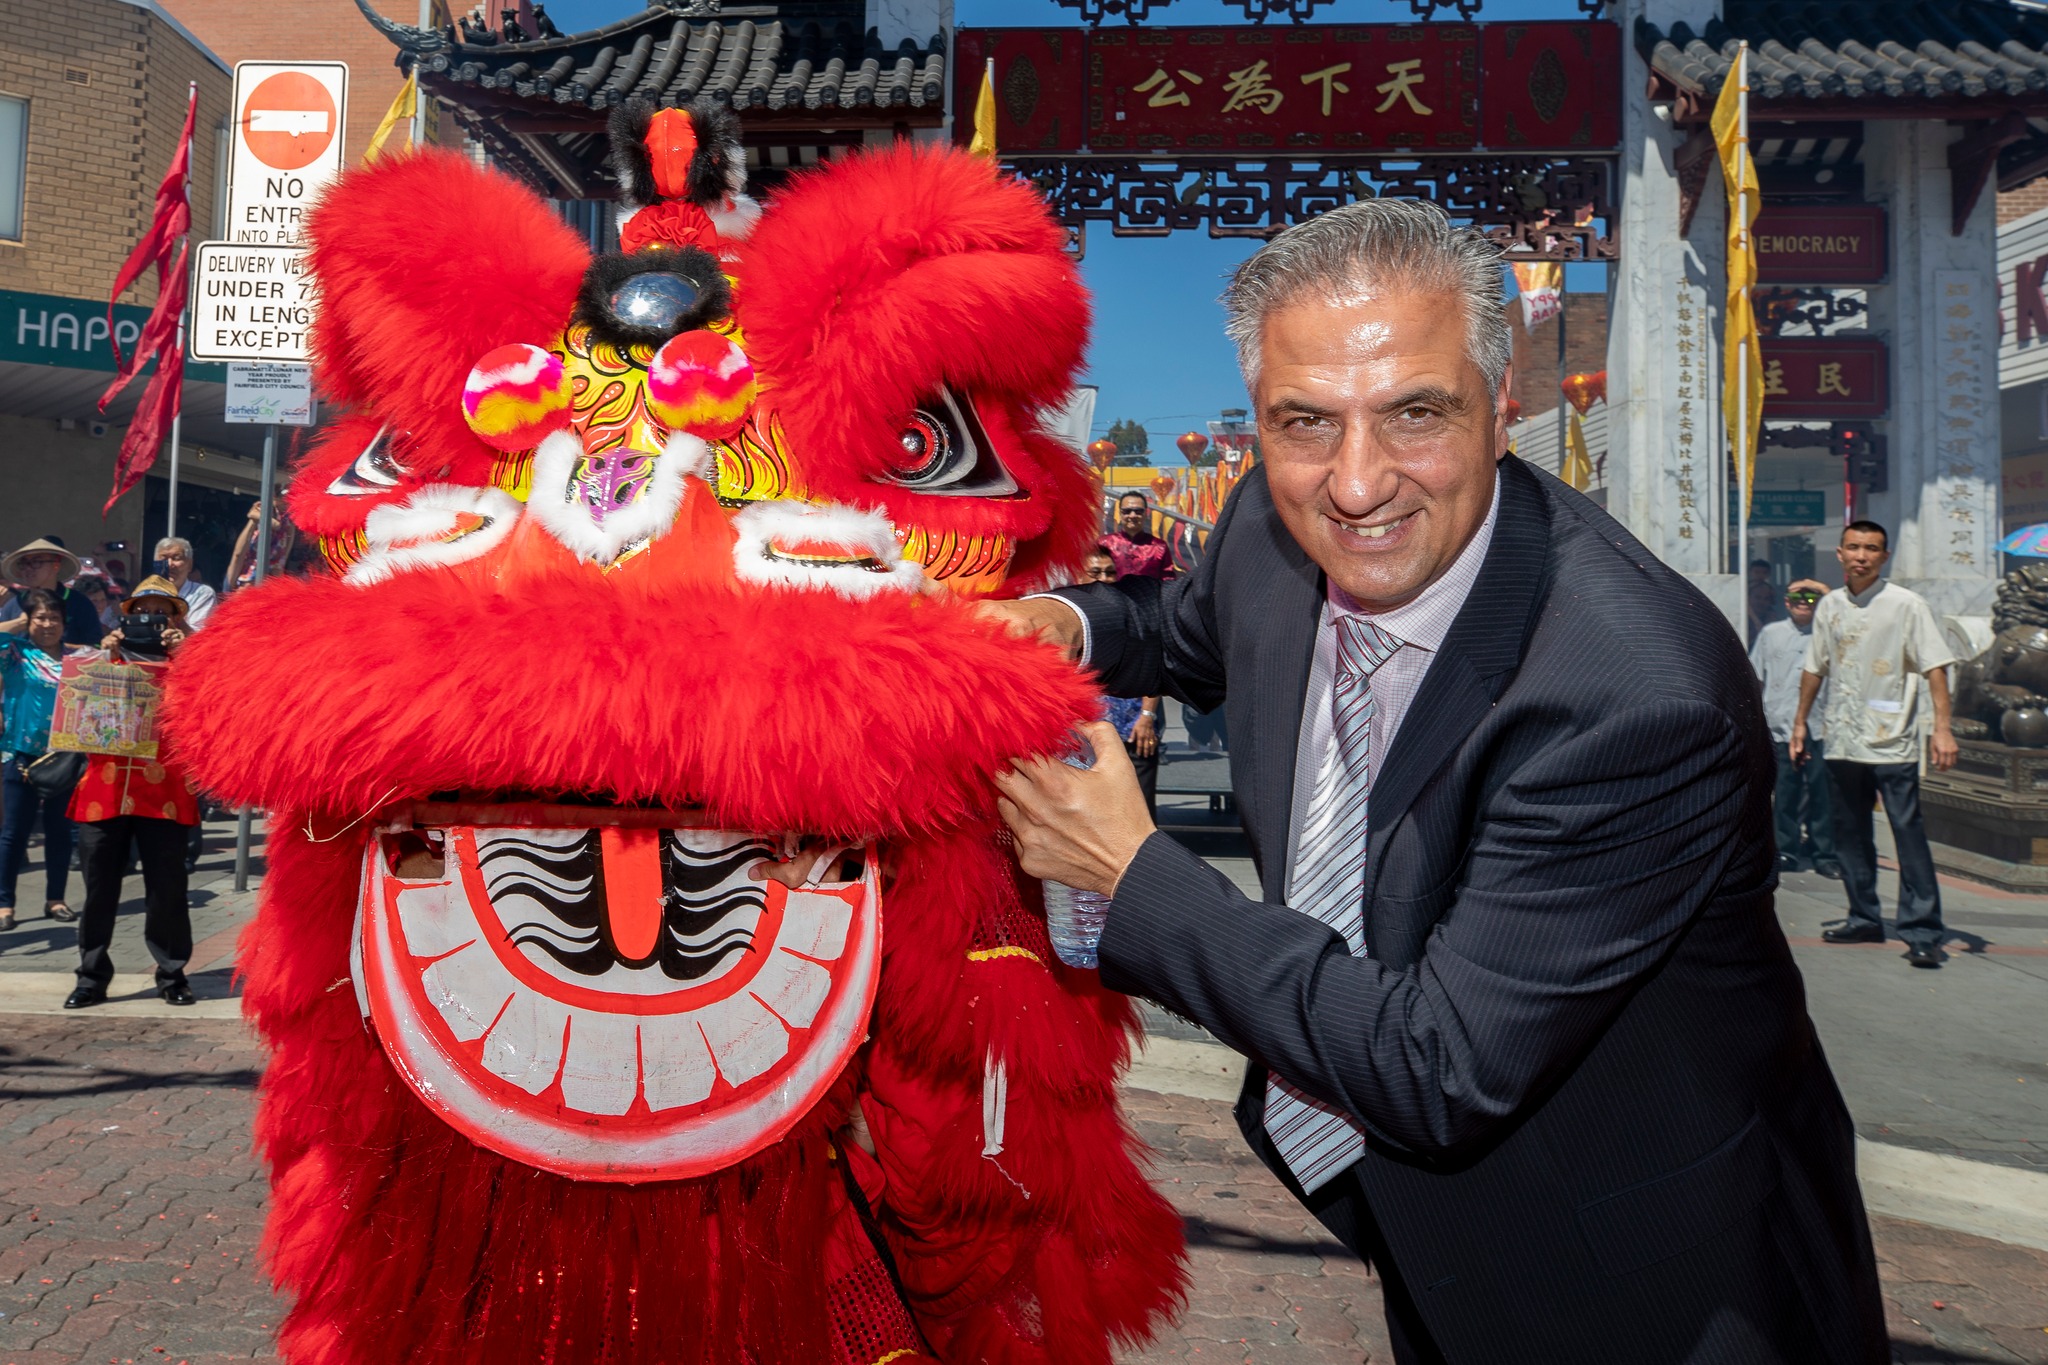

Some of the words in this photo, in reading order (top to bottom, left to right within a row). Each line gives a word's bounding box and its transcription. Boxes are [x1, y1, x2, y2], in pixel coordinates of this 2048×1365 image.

[266, 178, 303, 198] NO
[246, 206, 306, 224] ENTR
[237, 229, 268, 242] INTO
[276, 230, 308, 243] PLA
[208, 255, 275, 273] DELIVERY
[207, 280, 284, 299] UNDER
[216, 304, 236, 321] IN
[250, 305, 310, 325] LENG
[18, 308, 157, 358] HAPP
[216, 330, 304, 349] EXCEPT
